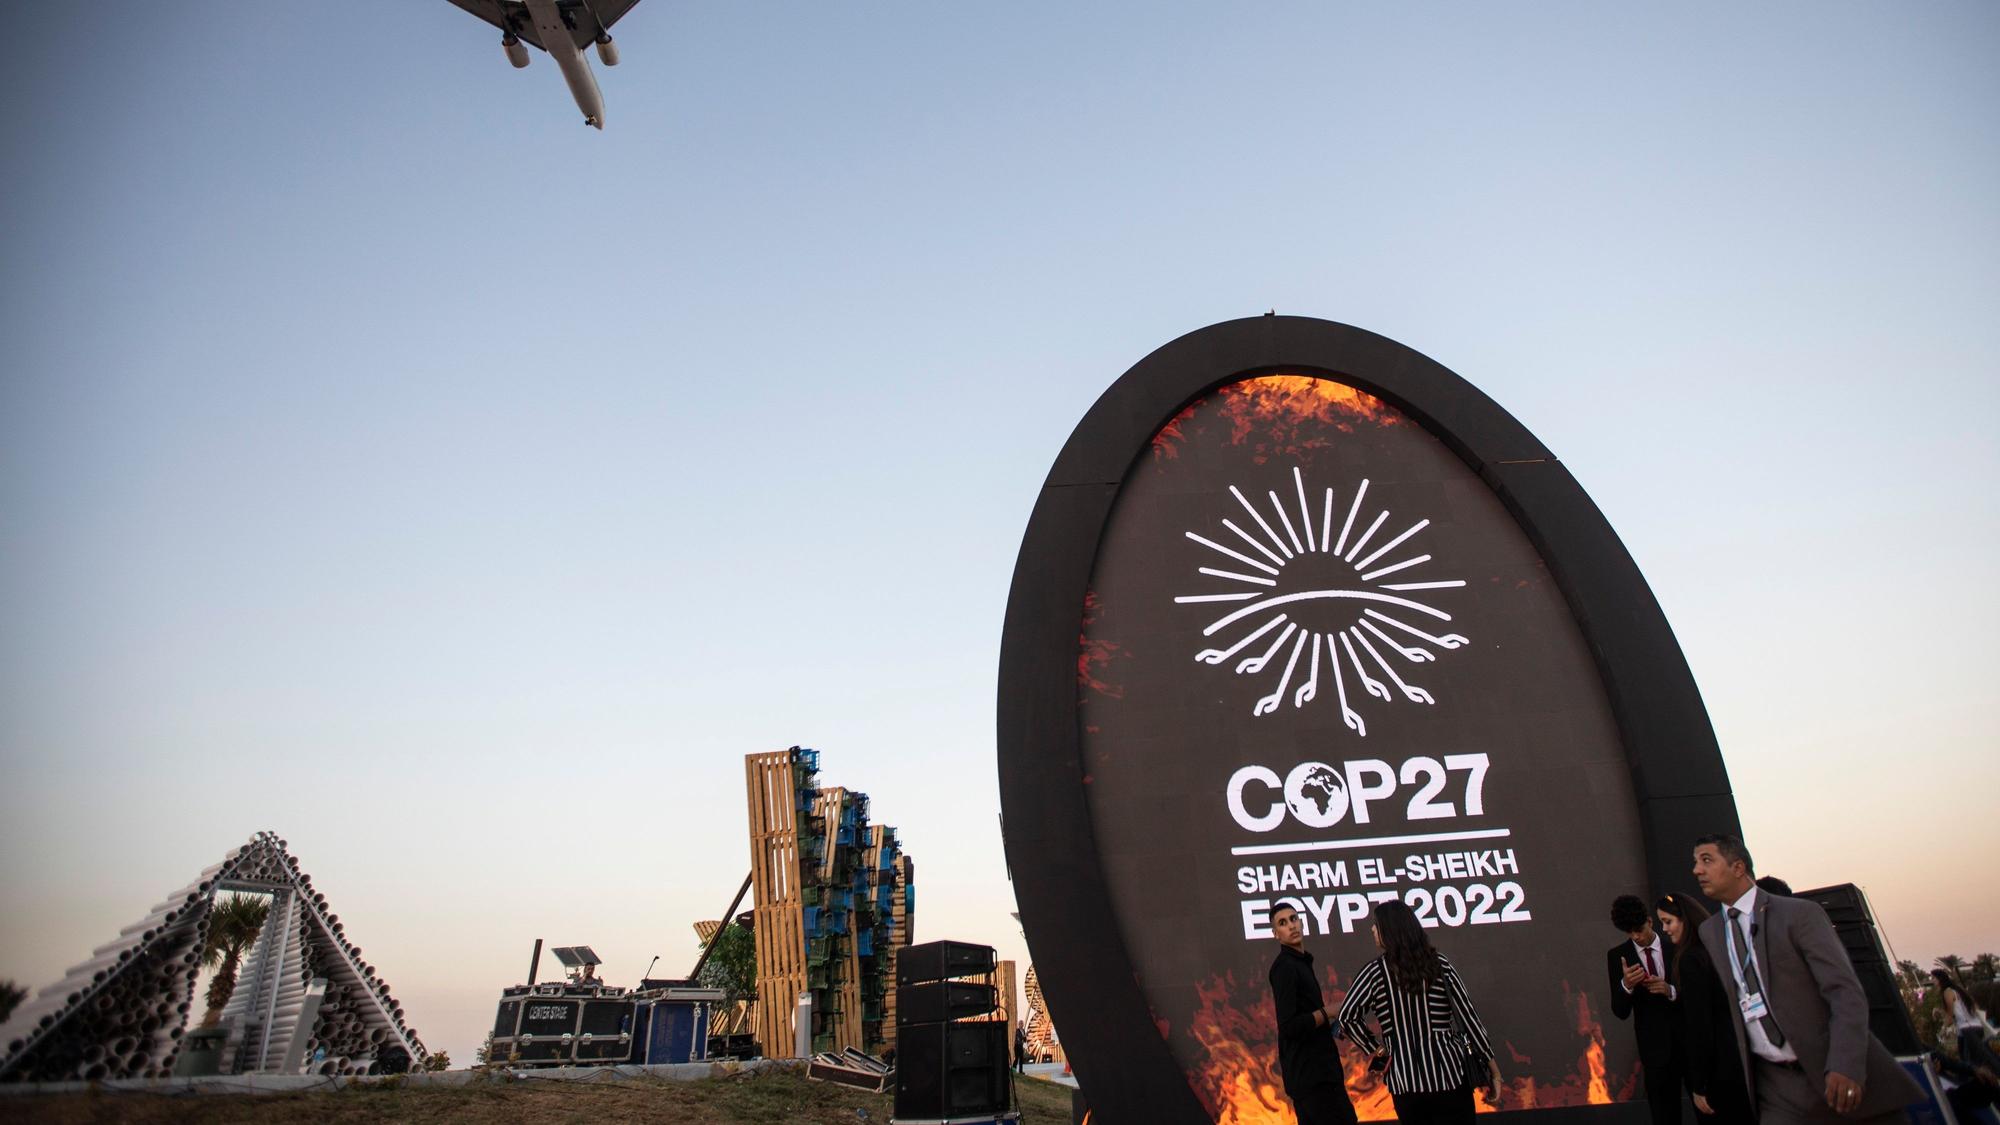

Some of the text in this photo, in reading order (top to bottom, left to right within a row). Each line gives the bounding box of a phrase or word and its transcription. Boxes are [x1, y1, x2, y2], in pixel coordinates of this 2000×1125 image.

[1227, 753, 1489, 832] COP27
[1238, 849, 1518, 893] SHARM EL-SHEIKH
[1405, 882, 1531, 928] 2022
[529, 1006, 568, 1020] CENTER STAGE
